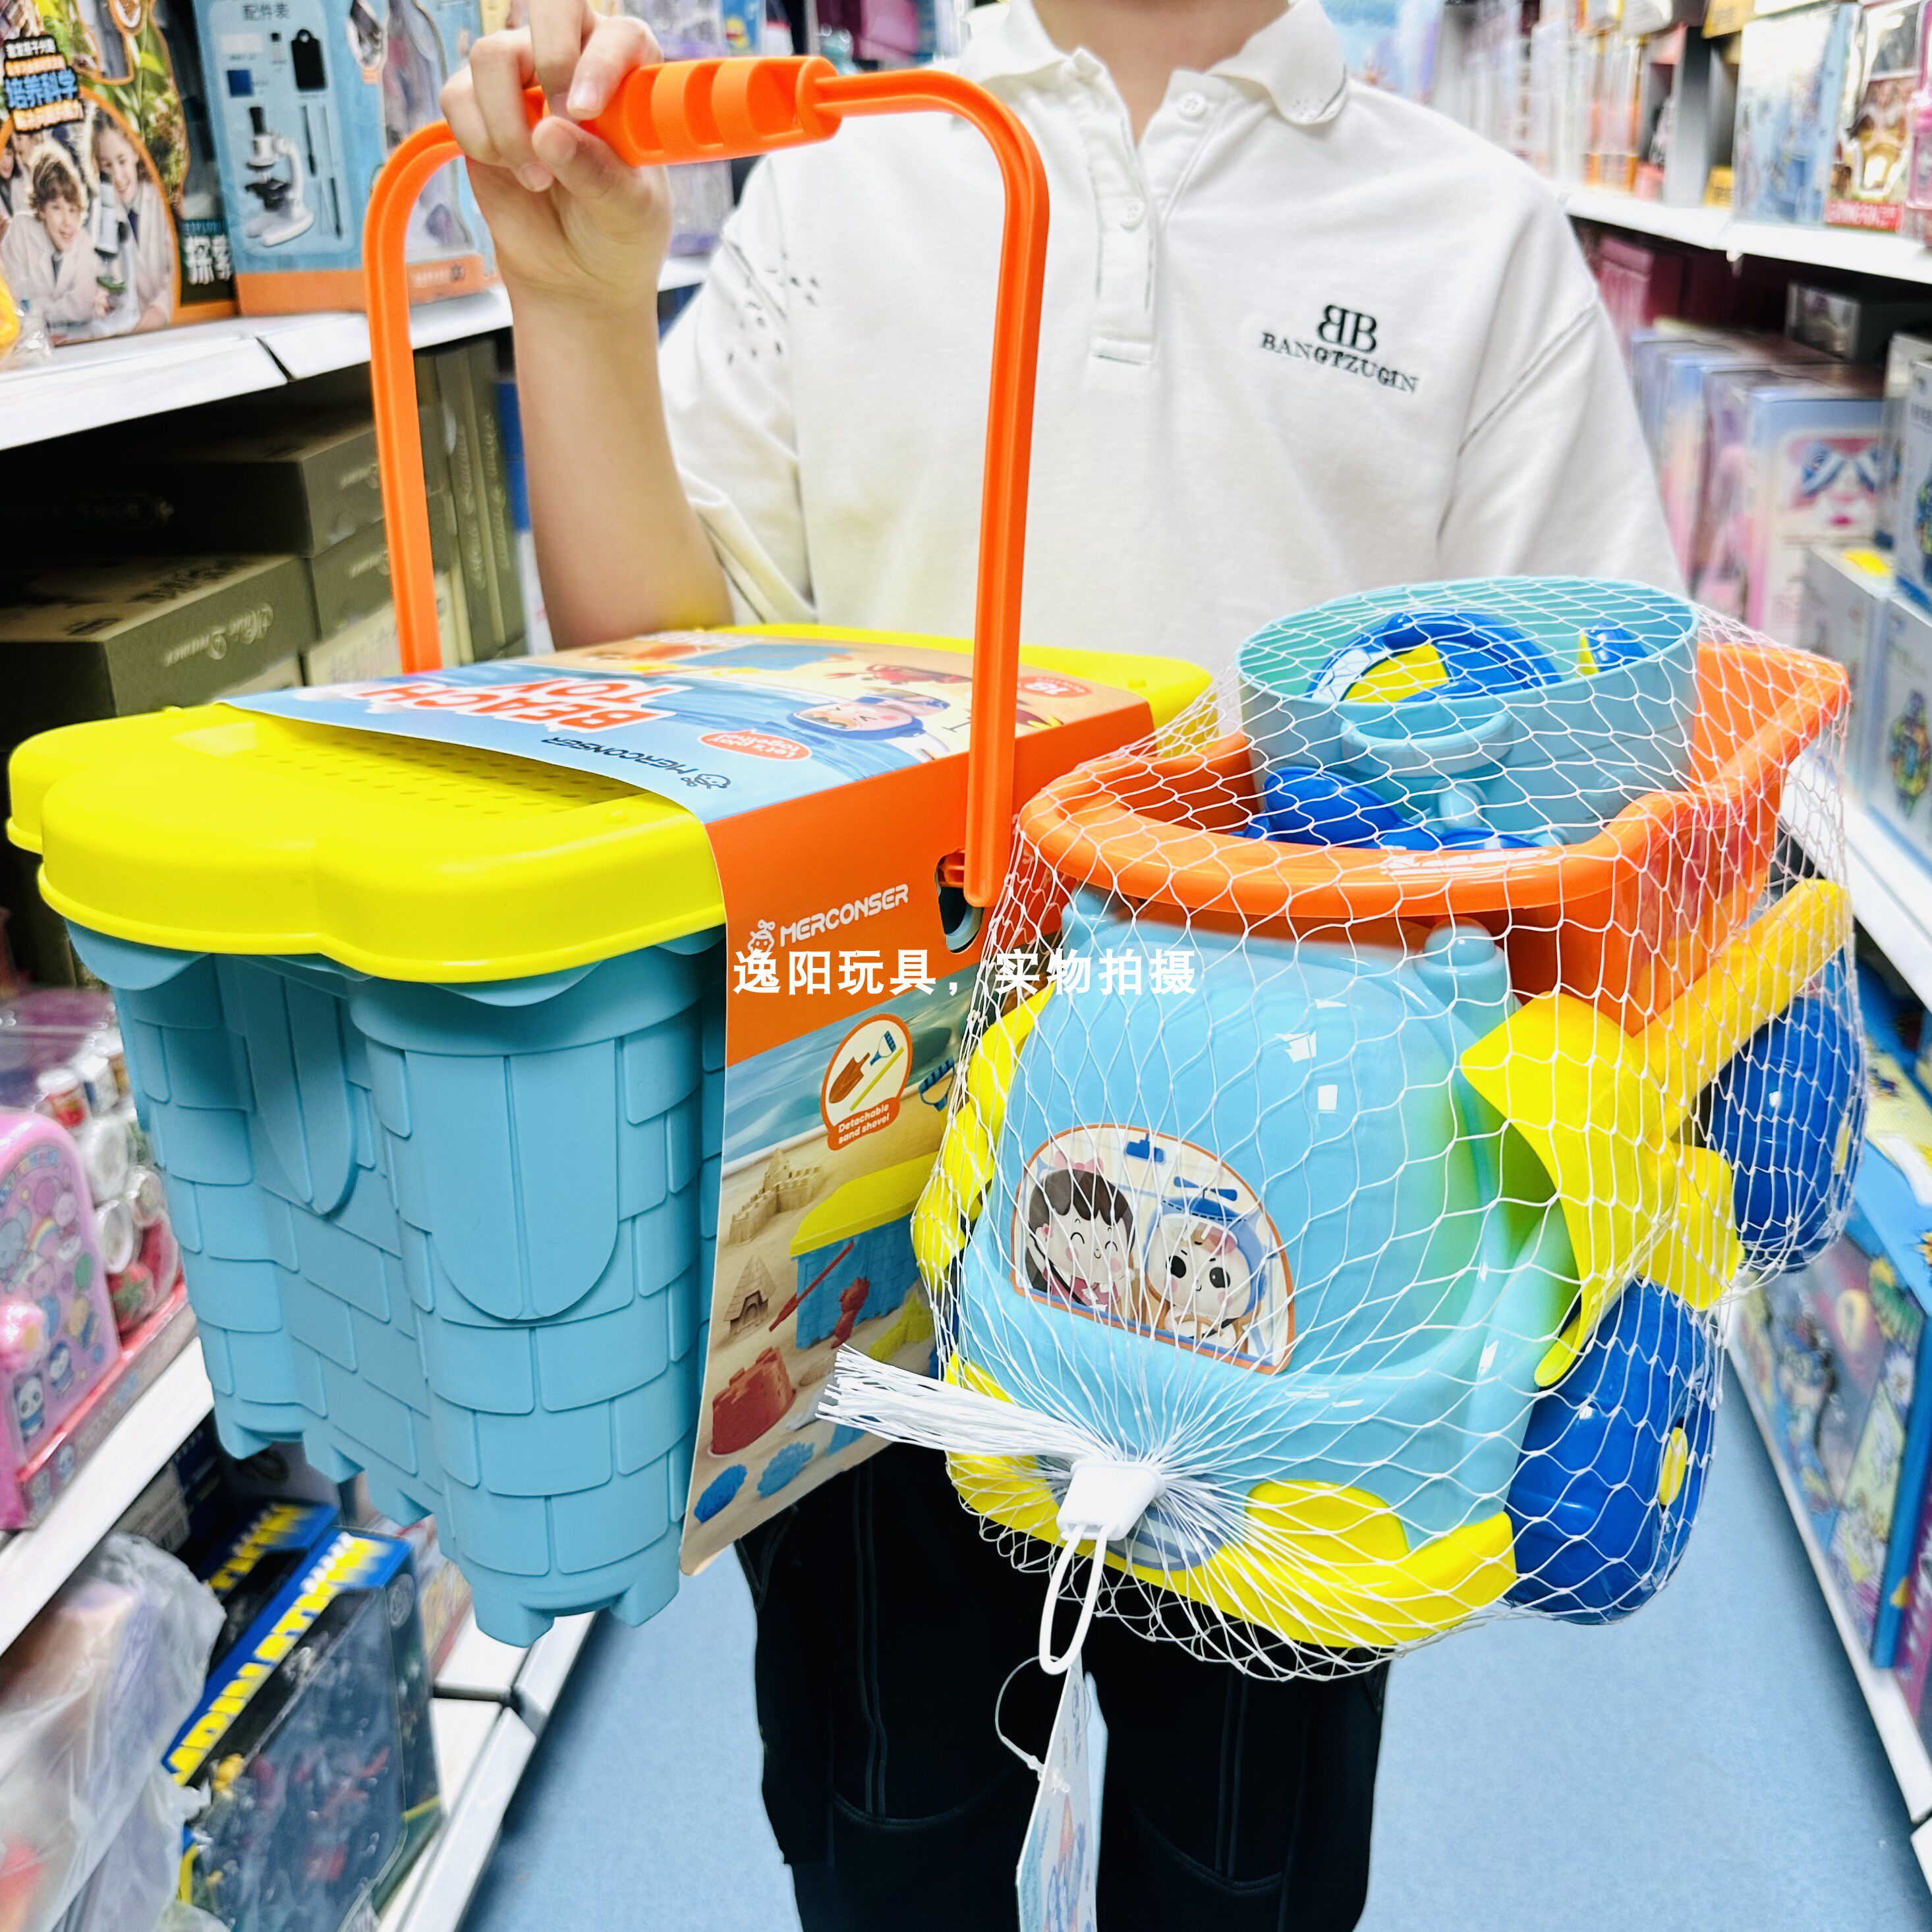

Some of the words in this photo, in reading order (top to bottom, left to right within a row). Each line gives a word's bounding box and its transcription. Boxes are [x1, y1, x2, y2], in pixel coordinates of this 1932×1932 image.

[358, 683, 660, 729] BEACH
[484, 678, 673, 704] TOY
[541, 737, 699, 774] MERCONSER
[780, 884, 909, 948] MERCONSER
[838, 1104, 889, 1133] Detachable
[838, 1126, 861, 1144] sand
[861, 1112, 890, 1133] shovel
